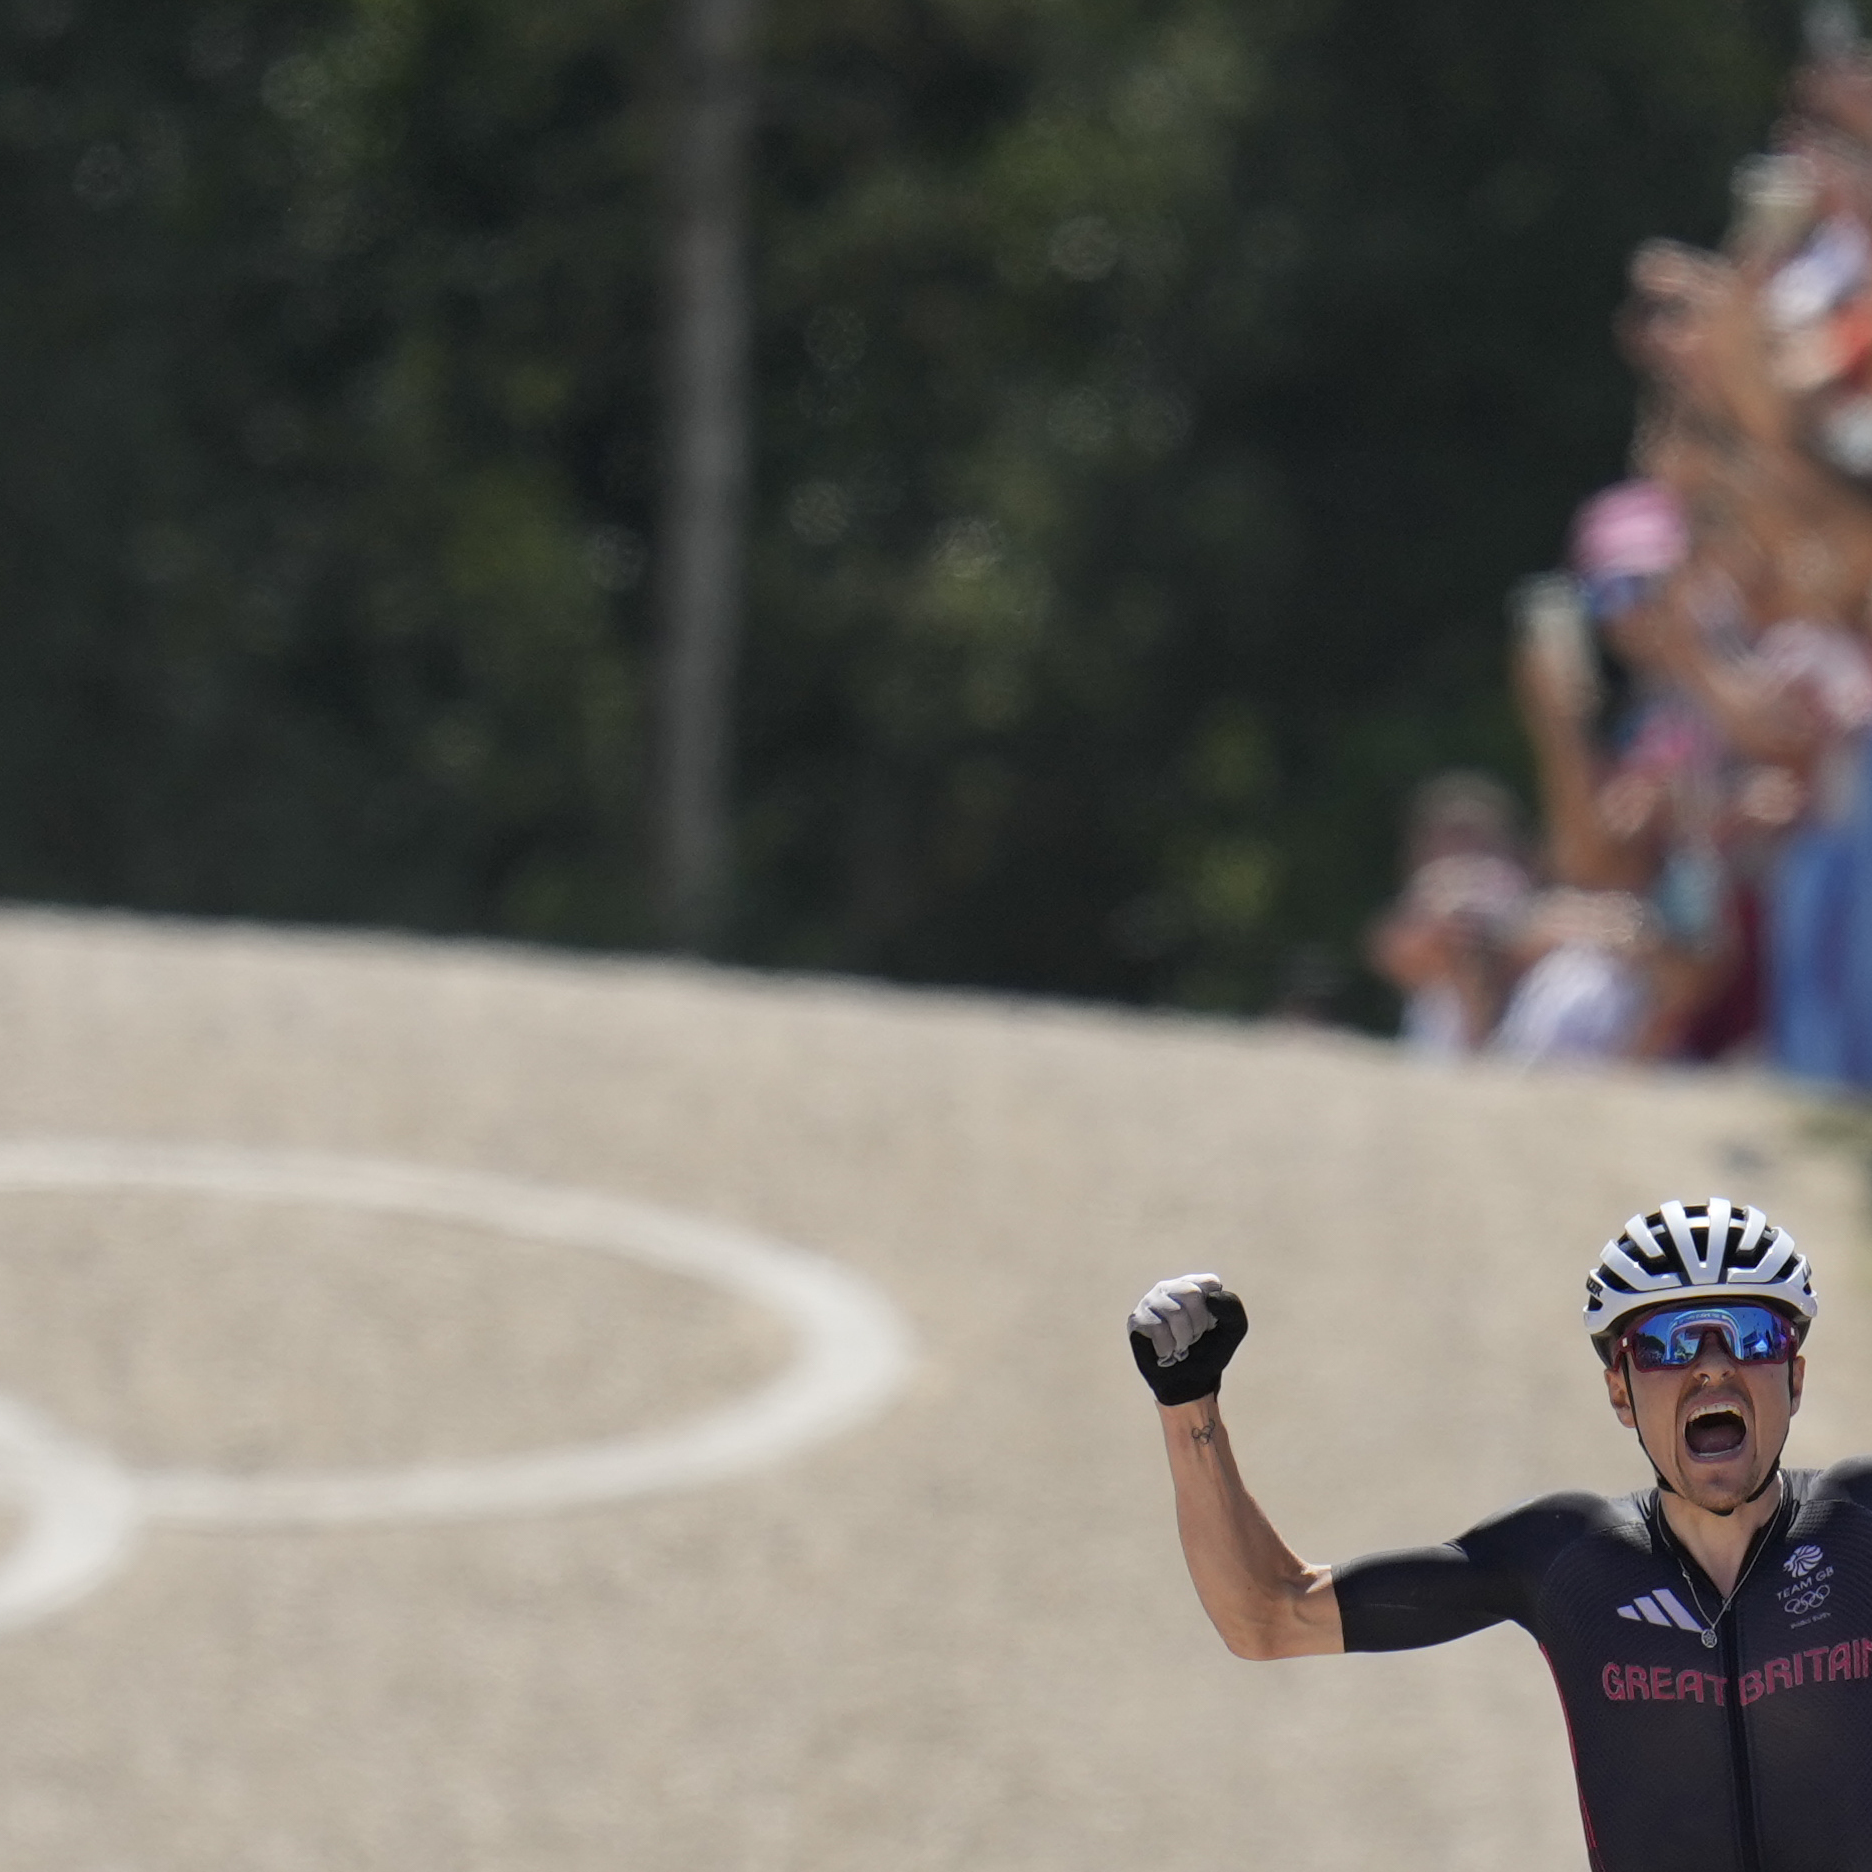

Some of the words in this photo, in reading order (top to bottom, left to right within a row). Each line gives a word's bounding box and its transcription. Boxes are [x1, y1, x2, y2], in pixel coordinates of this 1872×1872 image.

[1776, 1576, 1813, 1600] TEAM
[1815, 1566, 1834, 1581] GB
[1602, 1661, 1729, 1707] GREAT
